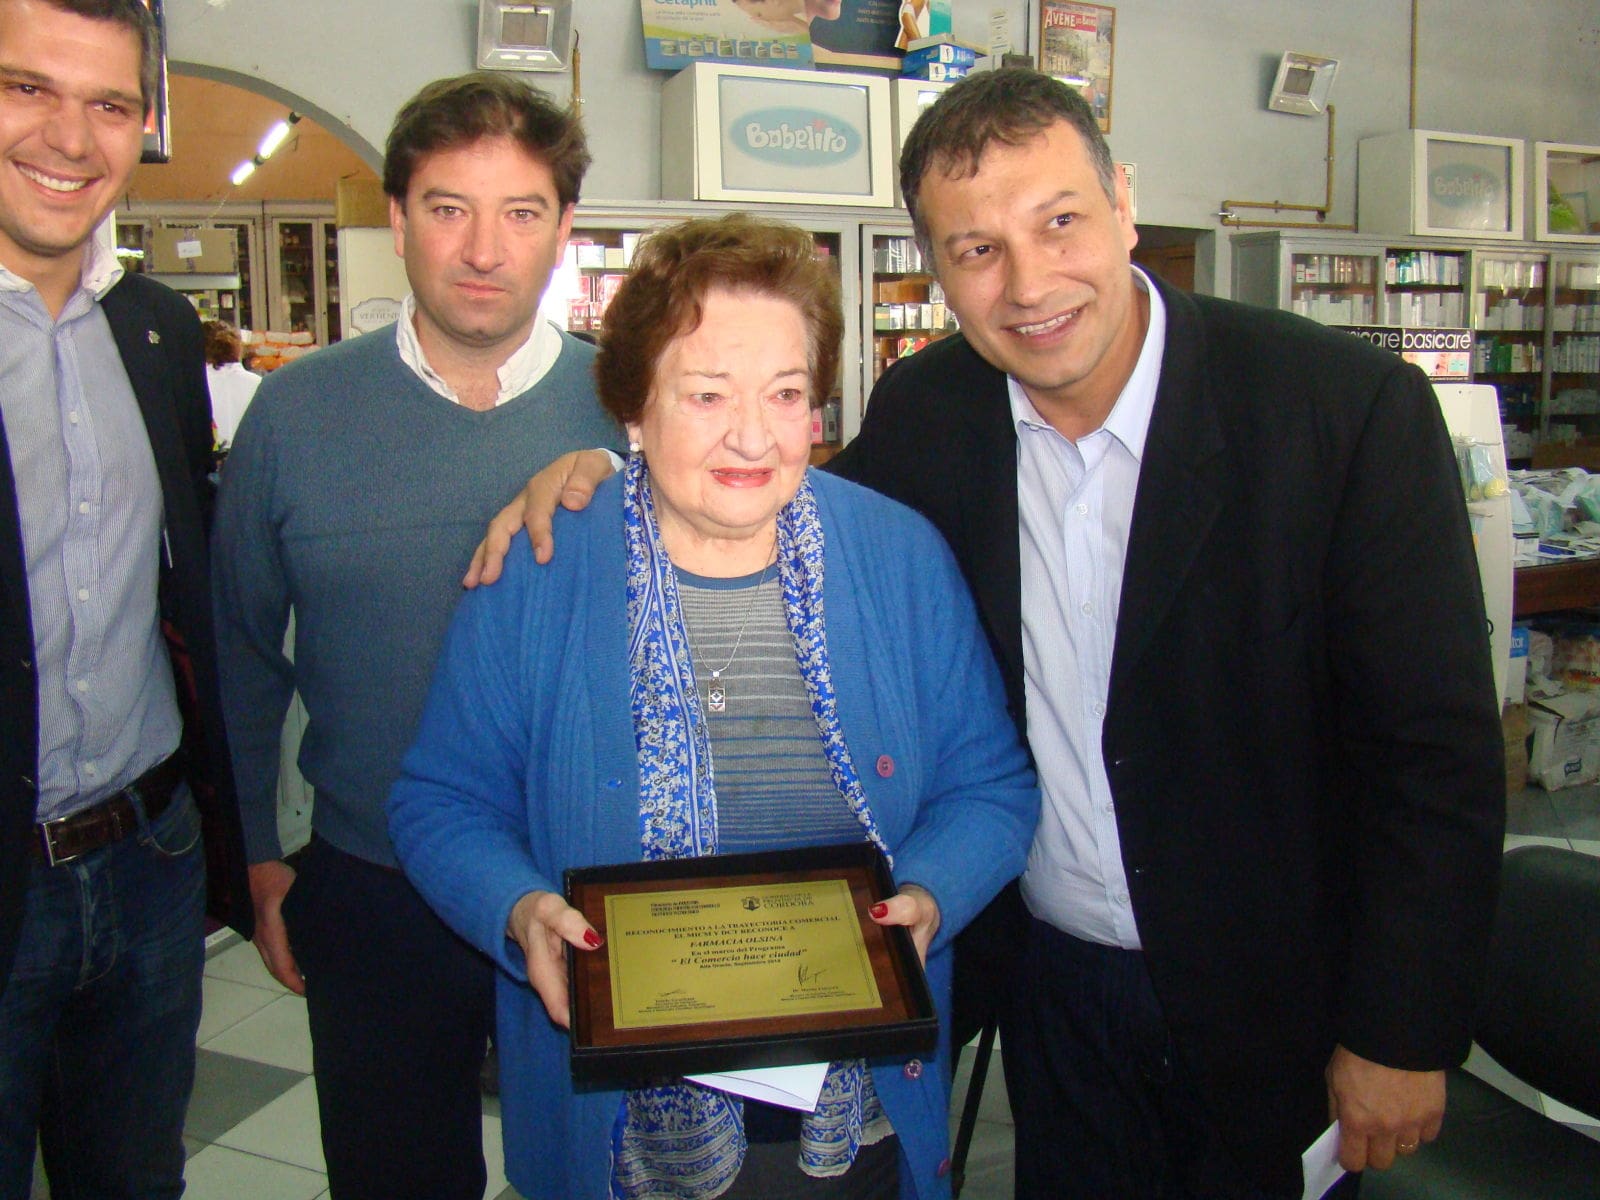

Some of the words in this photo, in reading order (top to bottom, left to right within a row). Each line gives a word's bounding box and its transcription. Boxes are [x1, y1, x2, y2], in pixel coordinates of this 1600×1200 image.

[745, 121, 847, 153] Babelito
[1401, 329, 1471, 349] basicare
[625, 926, 706, 936] RECONOCIMIENTO
[728, 920, 787, 929] TRAYECTORIA
[789, 916, 840, 925] COMERCIAL
[740, 926, 787, 934] RECONOCE
[690, 939, 743, 948] FARMACIA
[745, 935, 783, 944] OLSINA
[749, 945, 785, 953] Programa
[694, 954, 741, 964] Comercio
